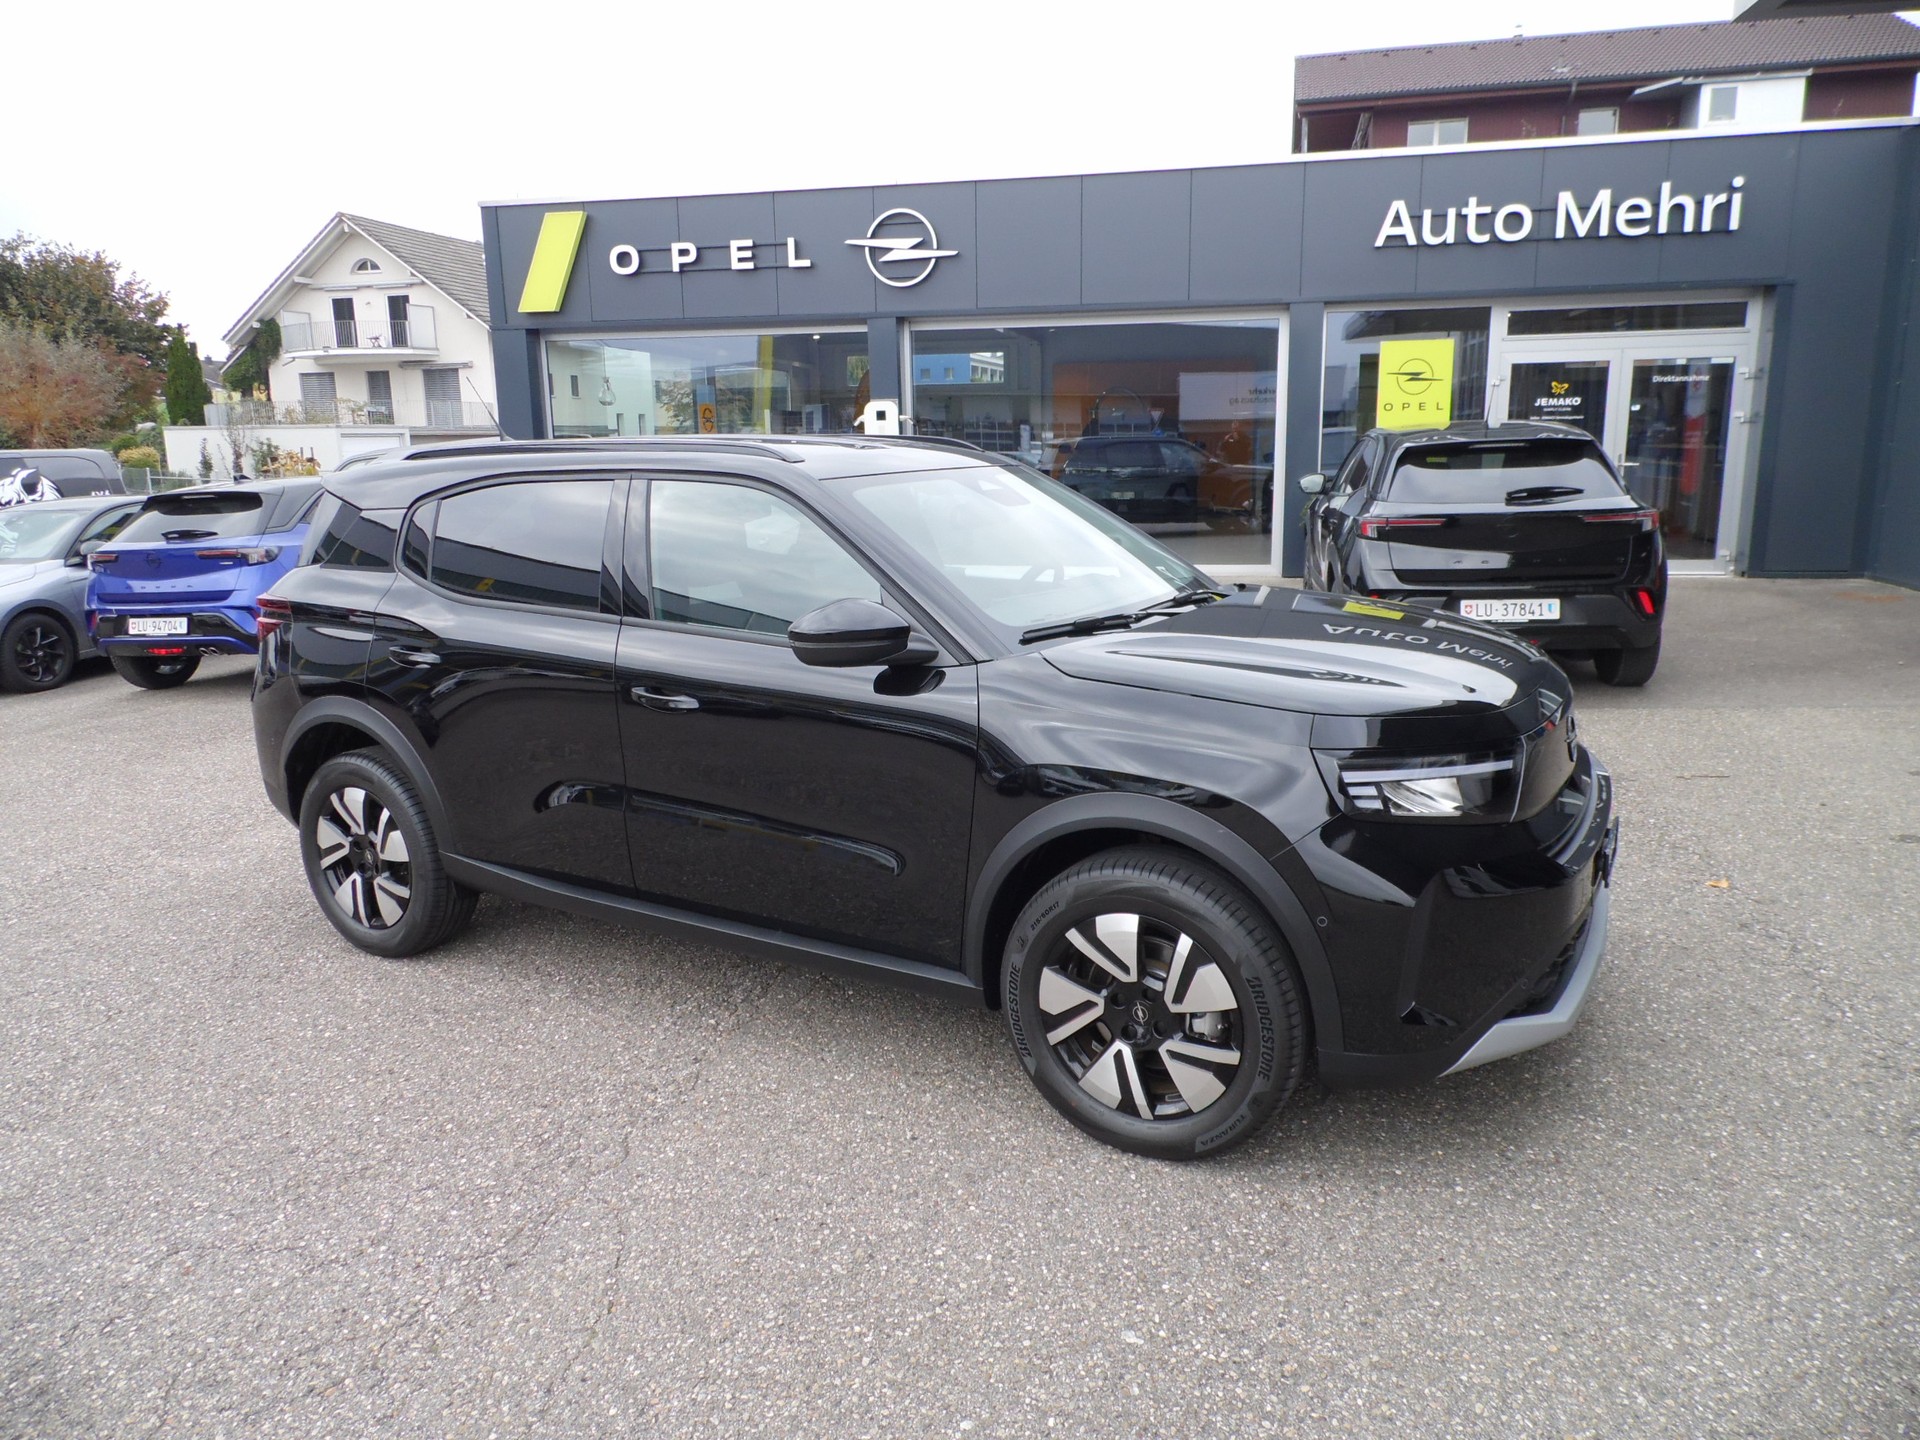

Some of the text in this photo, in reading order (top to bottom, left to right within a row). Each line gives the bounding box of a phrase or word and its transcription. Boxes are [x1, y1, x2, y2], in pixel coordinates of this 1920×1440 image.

[1374, 175, 1746, 248] Auto Mehri
[608, 236, 812, 277] OPEL
[1652, 375, 1710, 383] Direktannahme
[1383, 402, 1444, 412] OPEL
[1534, 397, 1582, 407] JEMAKO
[1007, 962, 1033, 1060] BRIDGESTONE
[1245, 976, 1278, 1083] BRIDGESTONE
[1200, 1114, 1247, 1146] TURANZA
